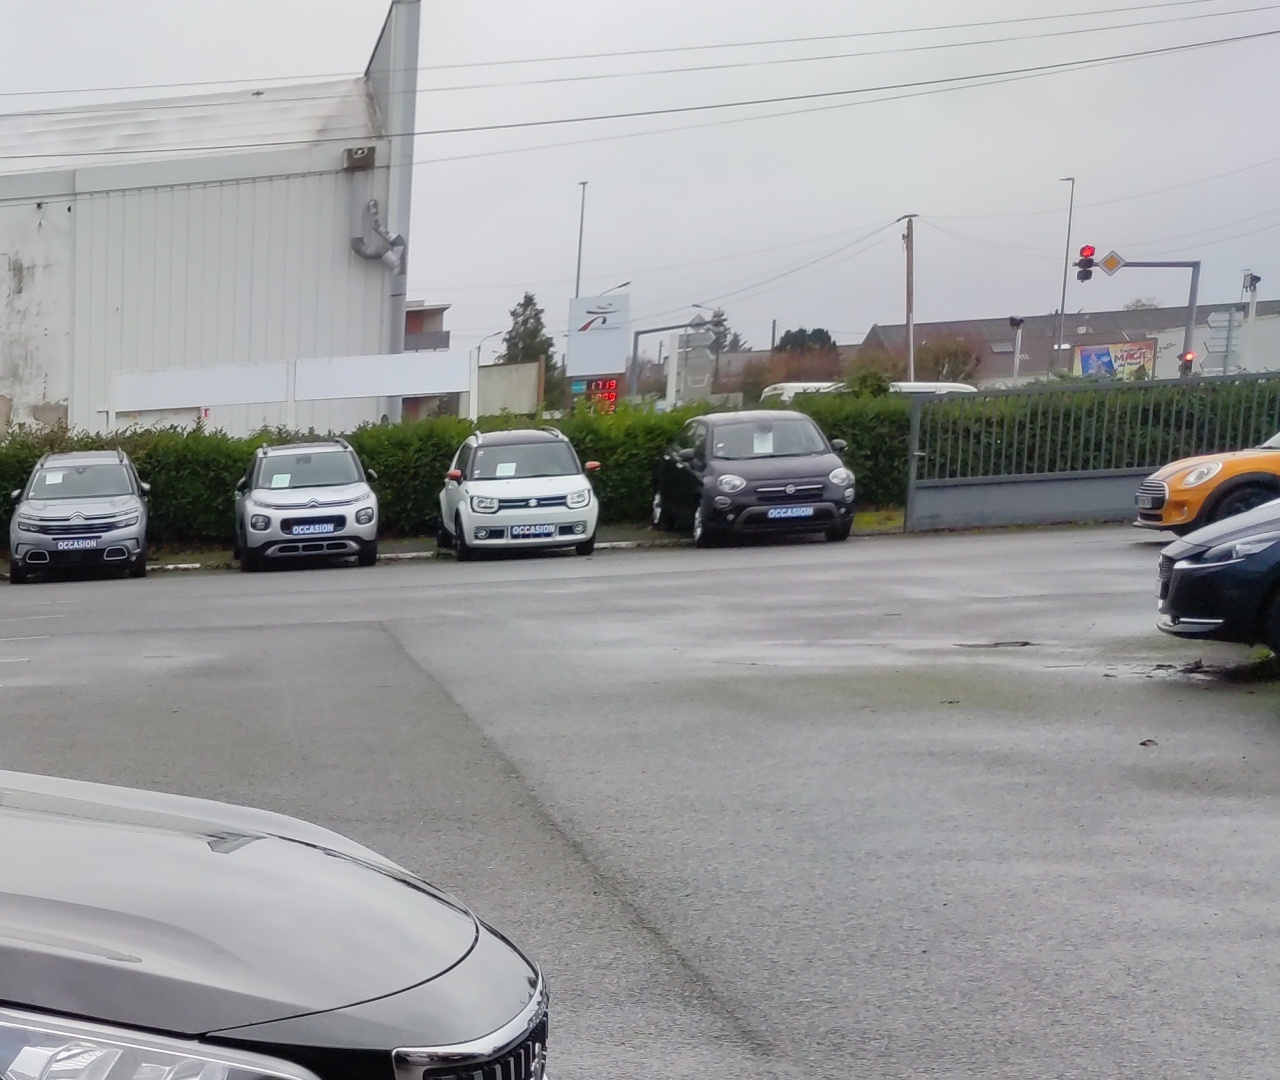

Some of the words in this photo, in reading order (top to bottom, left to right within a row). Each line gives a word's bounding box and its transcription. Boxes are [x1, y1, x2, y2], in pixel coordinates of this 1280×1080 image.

[767, 506, 814, 519] OCCASION
[292, 522, 335, 535] OCCASION
[511, 523, 555, 535] OCCASION
[57, 539, 97, 550] OCCASION
